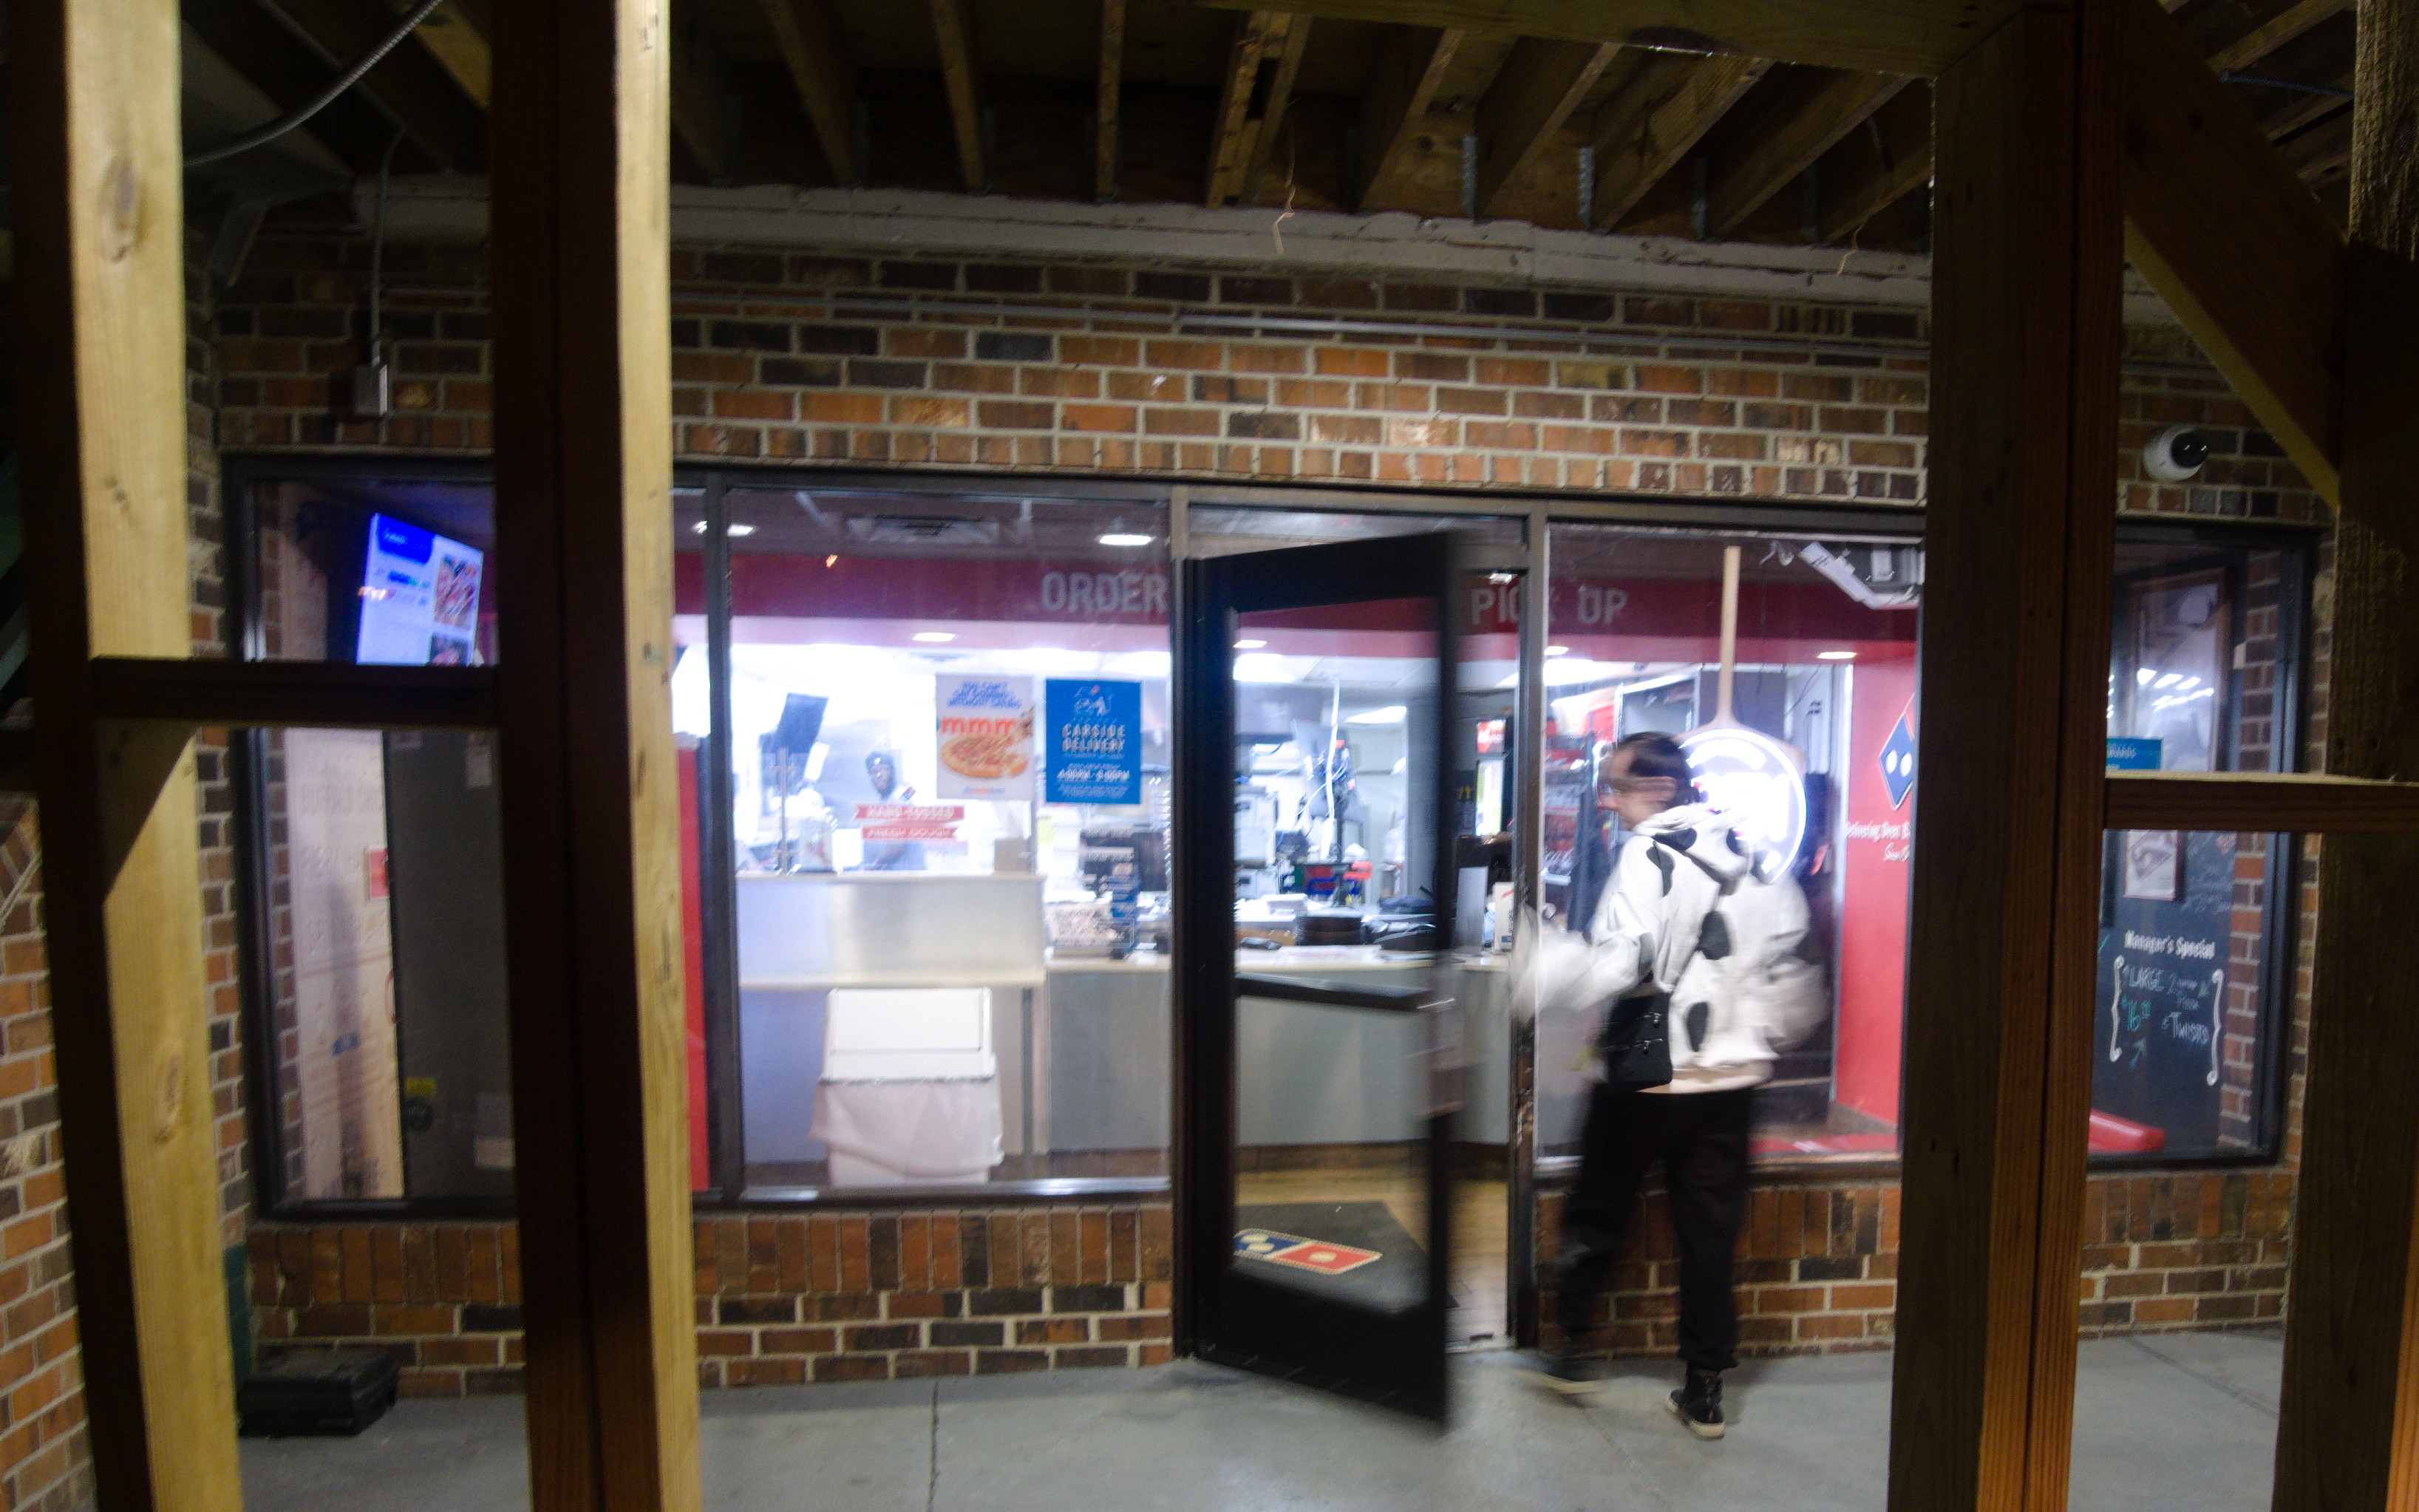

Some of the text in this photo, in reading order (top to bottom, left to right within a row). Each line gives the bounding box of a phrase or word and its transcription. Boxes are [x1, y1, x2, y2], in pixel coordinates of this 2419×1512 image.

[1040, 571, 1170, 613] ORDER
[1578, 585, 1629, 624] UP
[1062, 723, 1126, 738] CARSIDE
[1062, 738, 1126, 753] DELIVERY
[2125, 930, 2216, 960] Manager's Special
